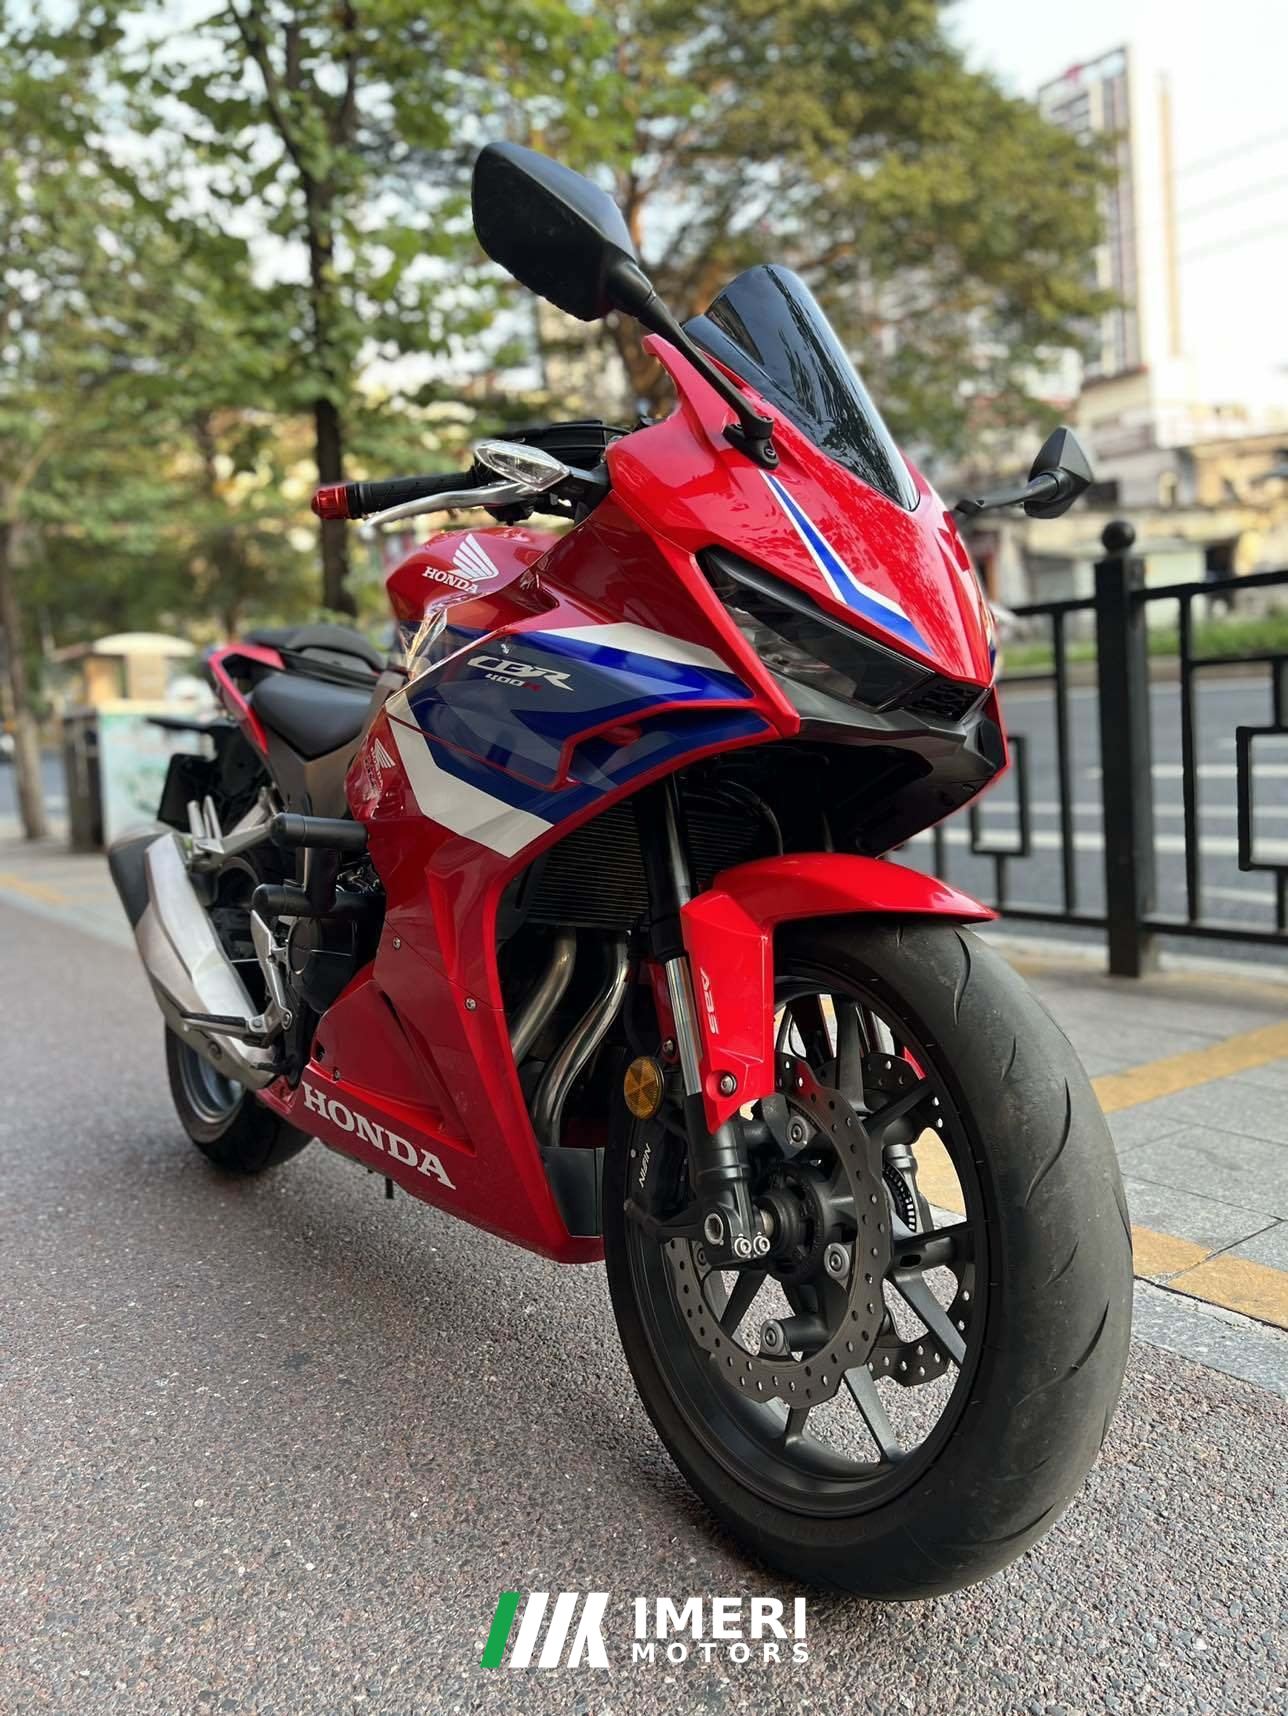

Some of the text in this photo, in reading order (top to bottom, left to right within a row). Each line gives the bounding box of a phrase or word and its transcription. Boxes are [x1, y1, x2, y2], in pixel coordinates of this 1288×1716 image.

[422, 566, 479, 593] HONDA
[467, 655, 574, 691] CBR
[700, 967, 719, 1035] ABS
[302, 1081, 456, 1190] HONDA
